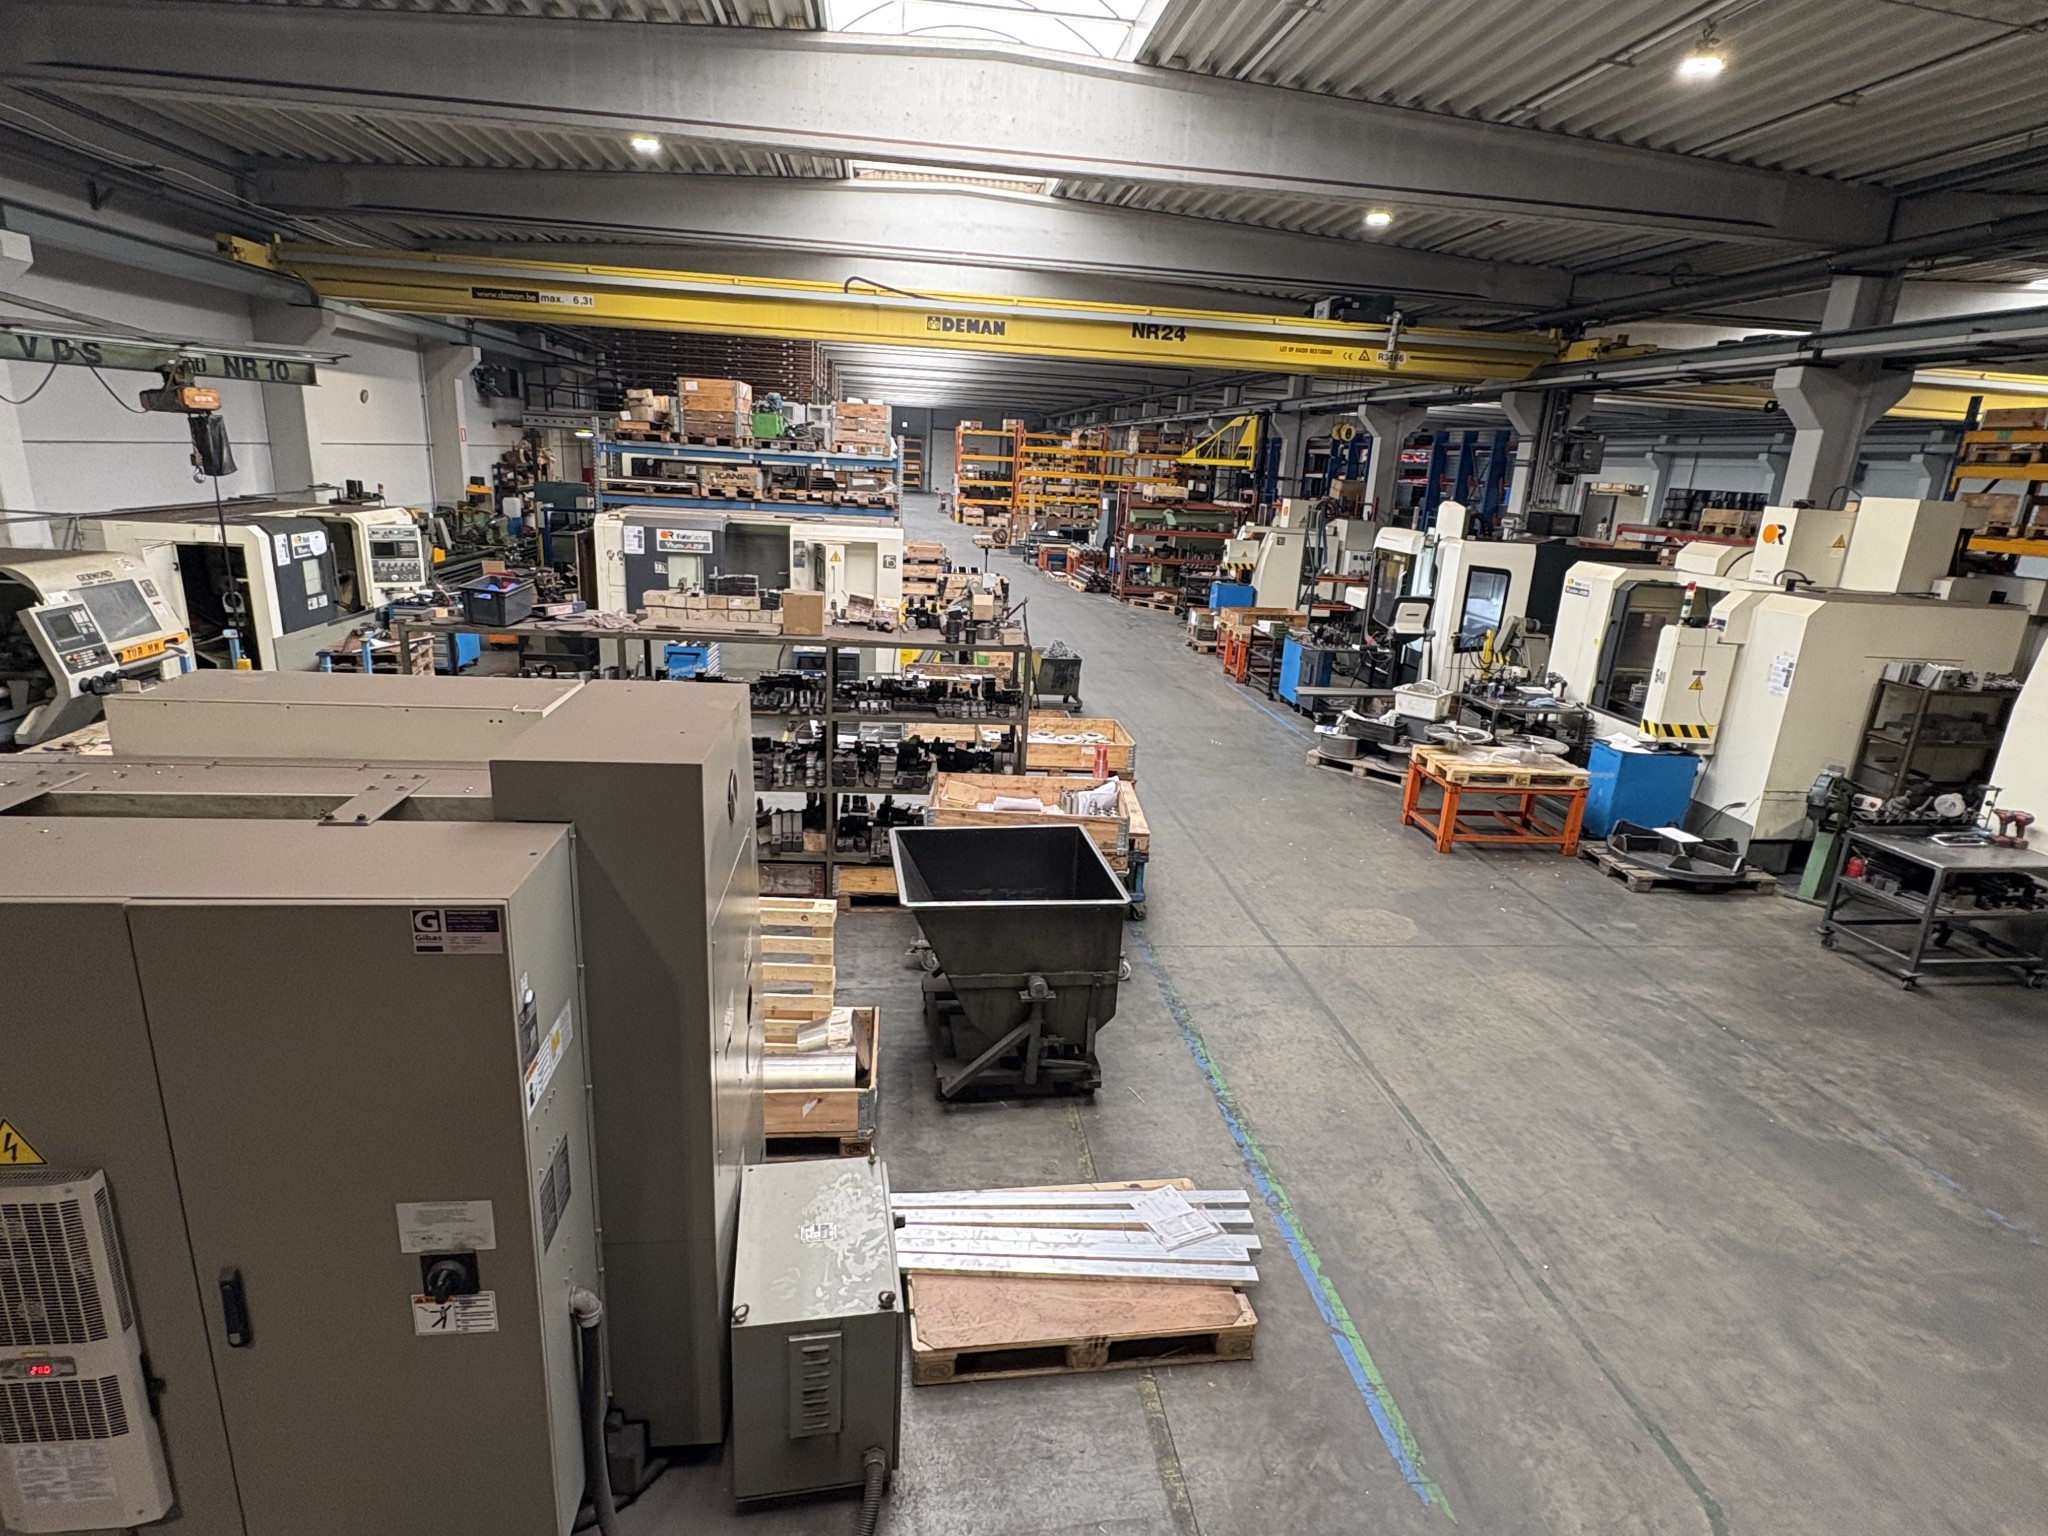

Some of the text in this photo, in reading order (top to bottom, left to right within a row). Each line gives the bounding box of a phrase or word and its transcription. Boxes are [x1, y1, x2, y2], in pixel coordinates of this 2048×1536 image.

[475, 291, 593, 306] www.deman.be max. 6,3t
[942, 317, 1006, 336] DEMAN
[1131, 322, 1187, 342] NR24
[222, 355, 260, 379] NR
[266, 362, 291, 382] 10
